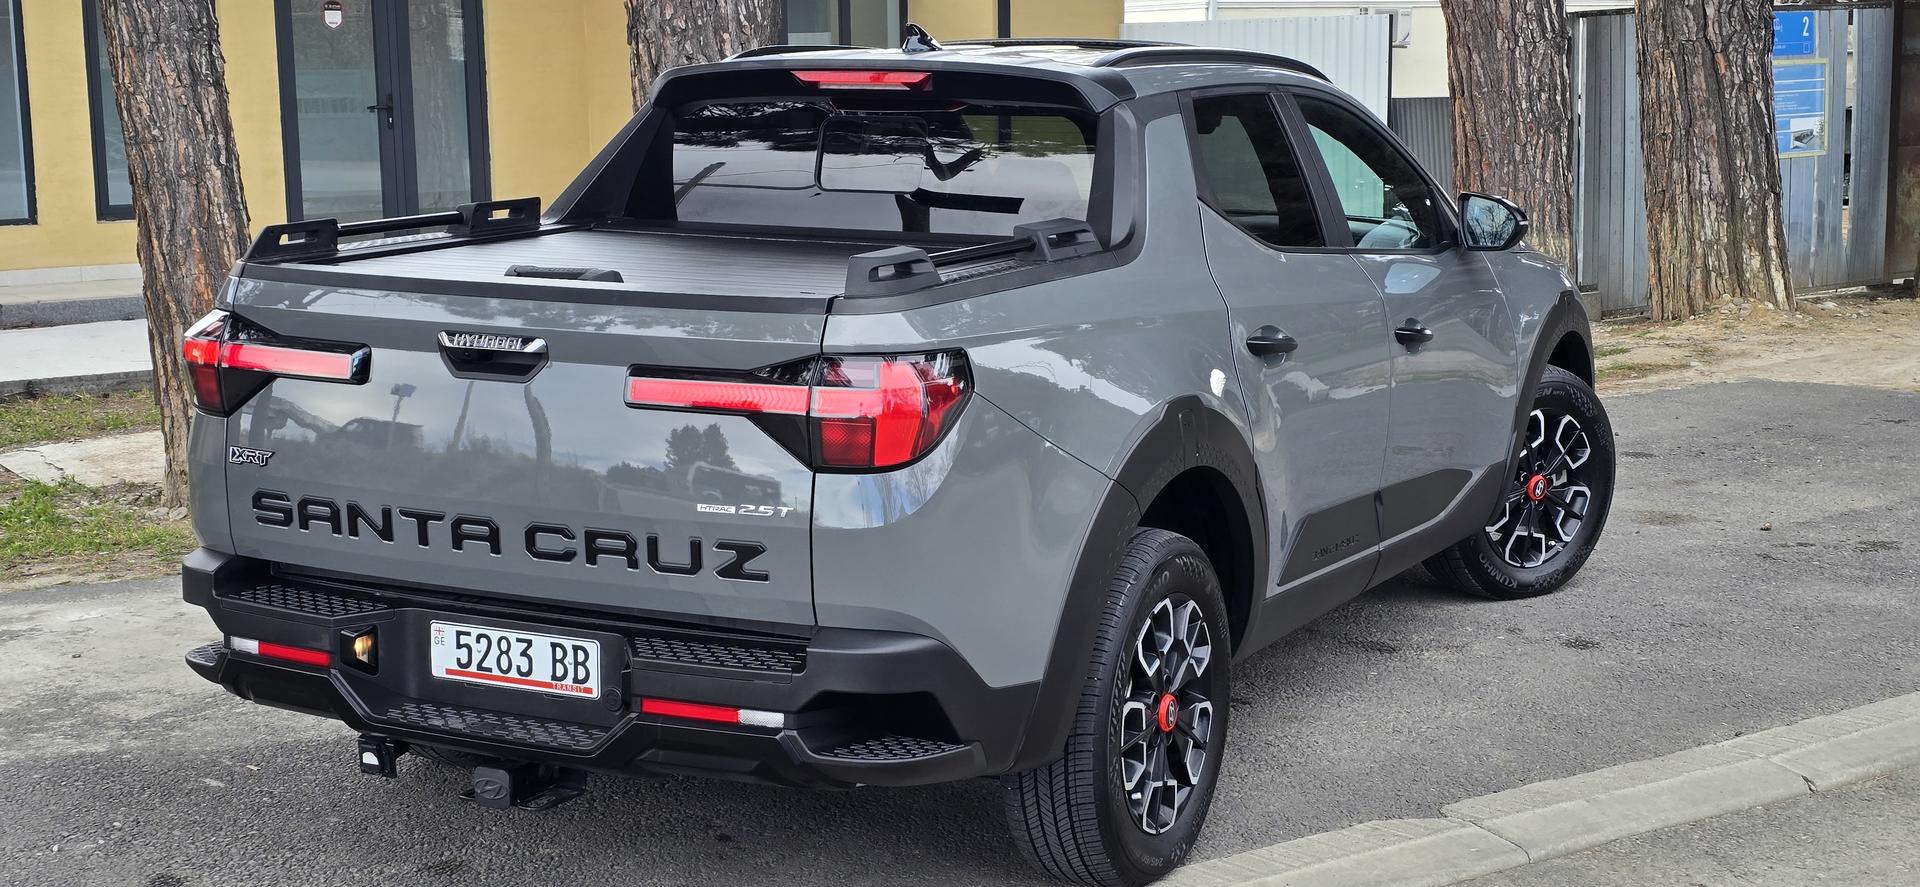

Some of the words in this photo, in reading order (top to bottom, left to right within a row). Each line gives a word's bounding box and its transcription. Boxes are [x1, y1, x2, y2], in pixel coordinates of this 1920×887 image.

[1802, 15, 1810, 37] 2
[453, 333, 523, 350] HYUNDAI
[229, 446, 273, 466] XRT
[698, 504, 734, 513] HTRAC
[252, 488, 502, 557] SANTA
[524, 521, 770, 583] CRUZ
[1479, 553, 1518, 589] KUMHO
[434, 636, 446, 646] GE
[455, 629, 534, 678] 5283
[550, 641, 591, 685] BB
[552, 683, 585, 693] TRANSIT
